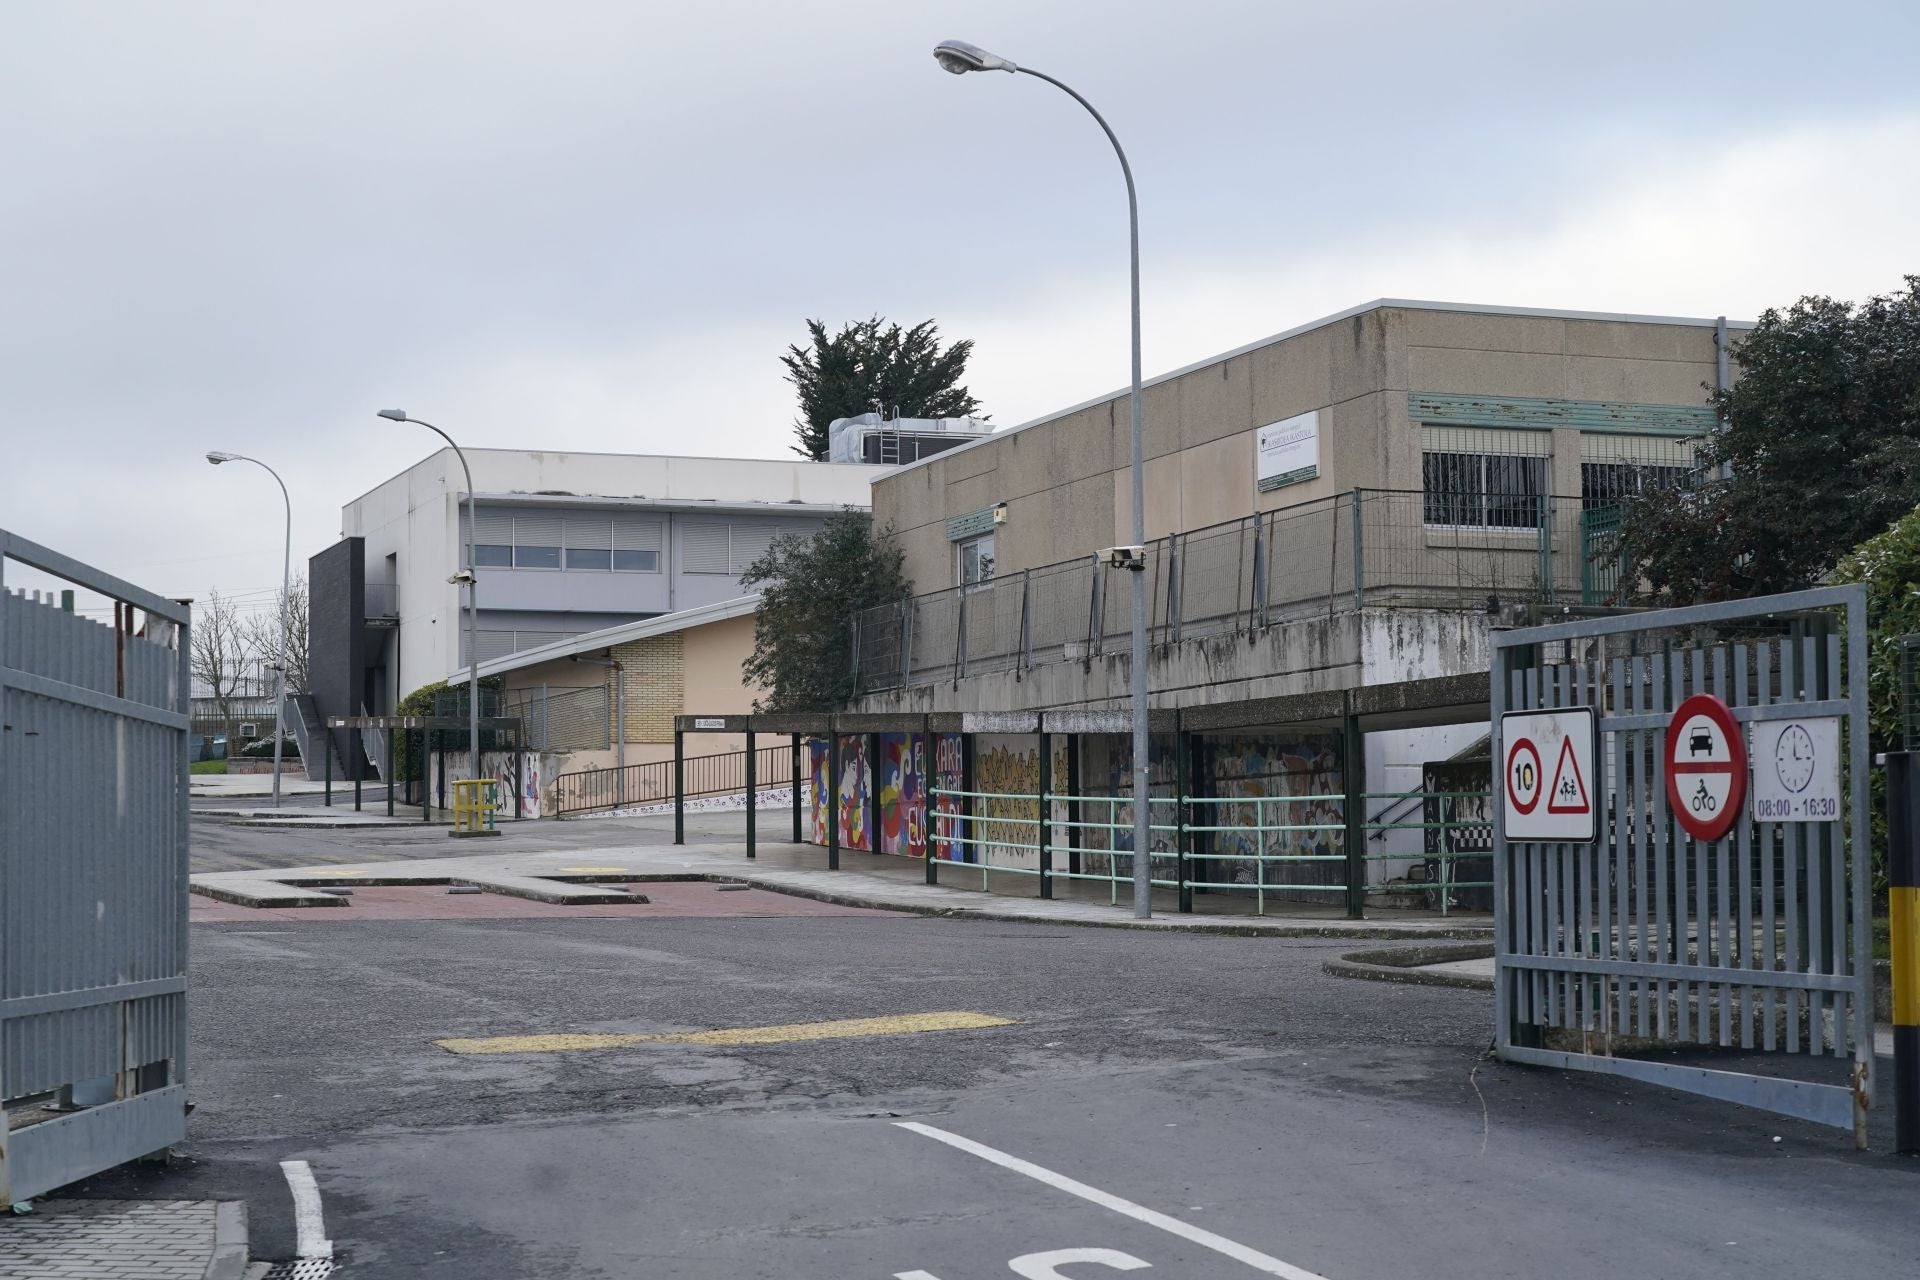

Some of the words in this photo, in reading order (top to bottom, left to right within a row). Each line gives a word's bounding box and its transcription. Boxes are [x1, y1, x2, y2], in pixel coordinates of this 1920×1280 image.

[1515, 762, 1533, 791] 10
[1758, 799, 1791, 817] 08:00
[1802, 798, 1836, 816] 16:30
